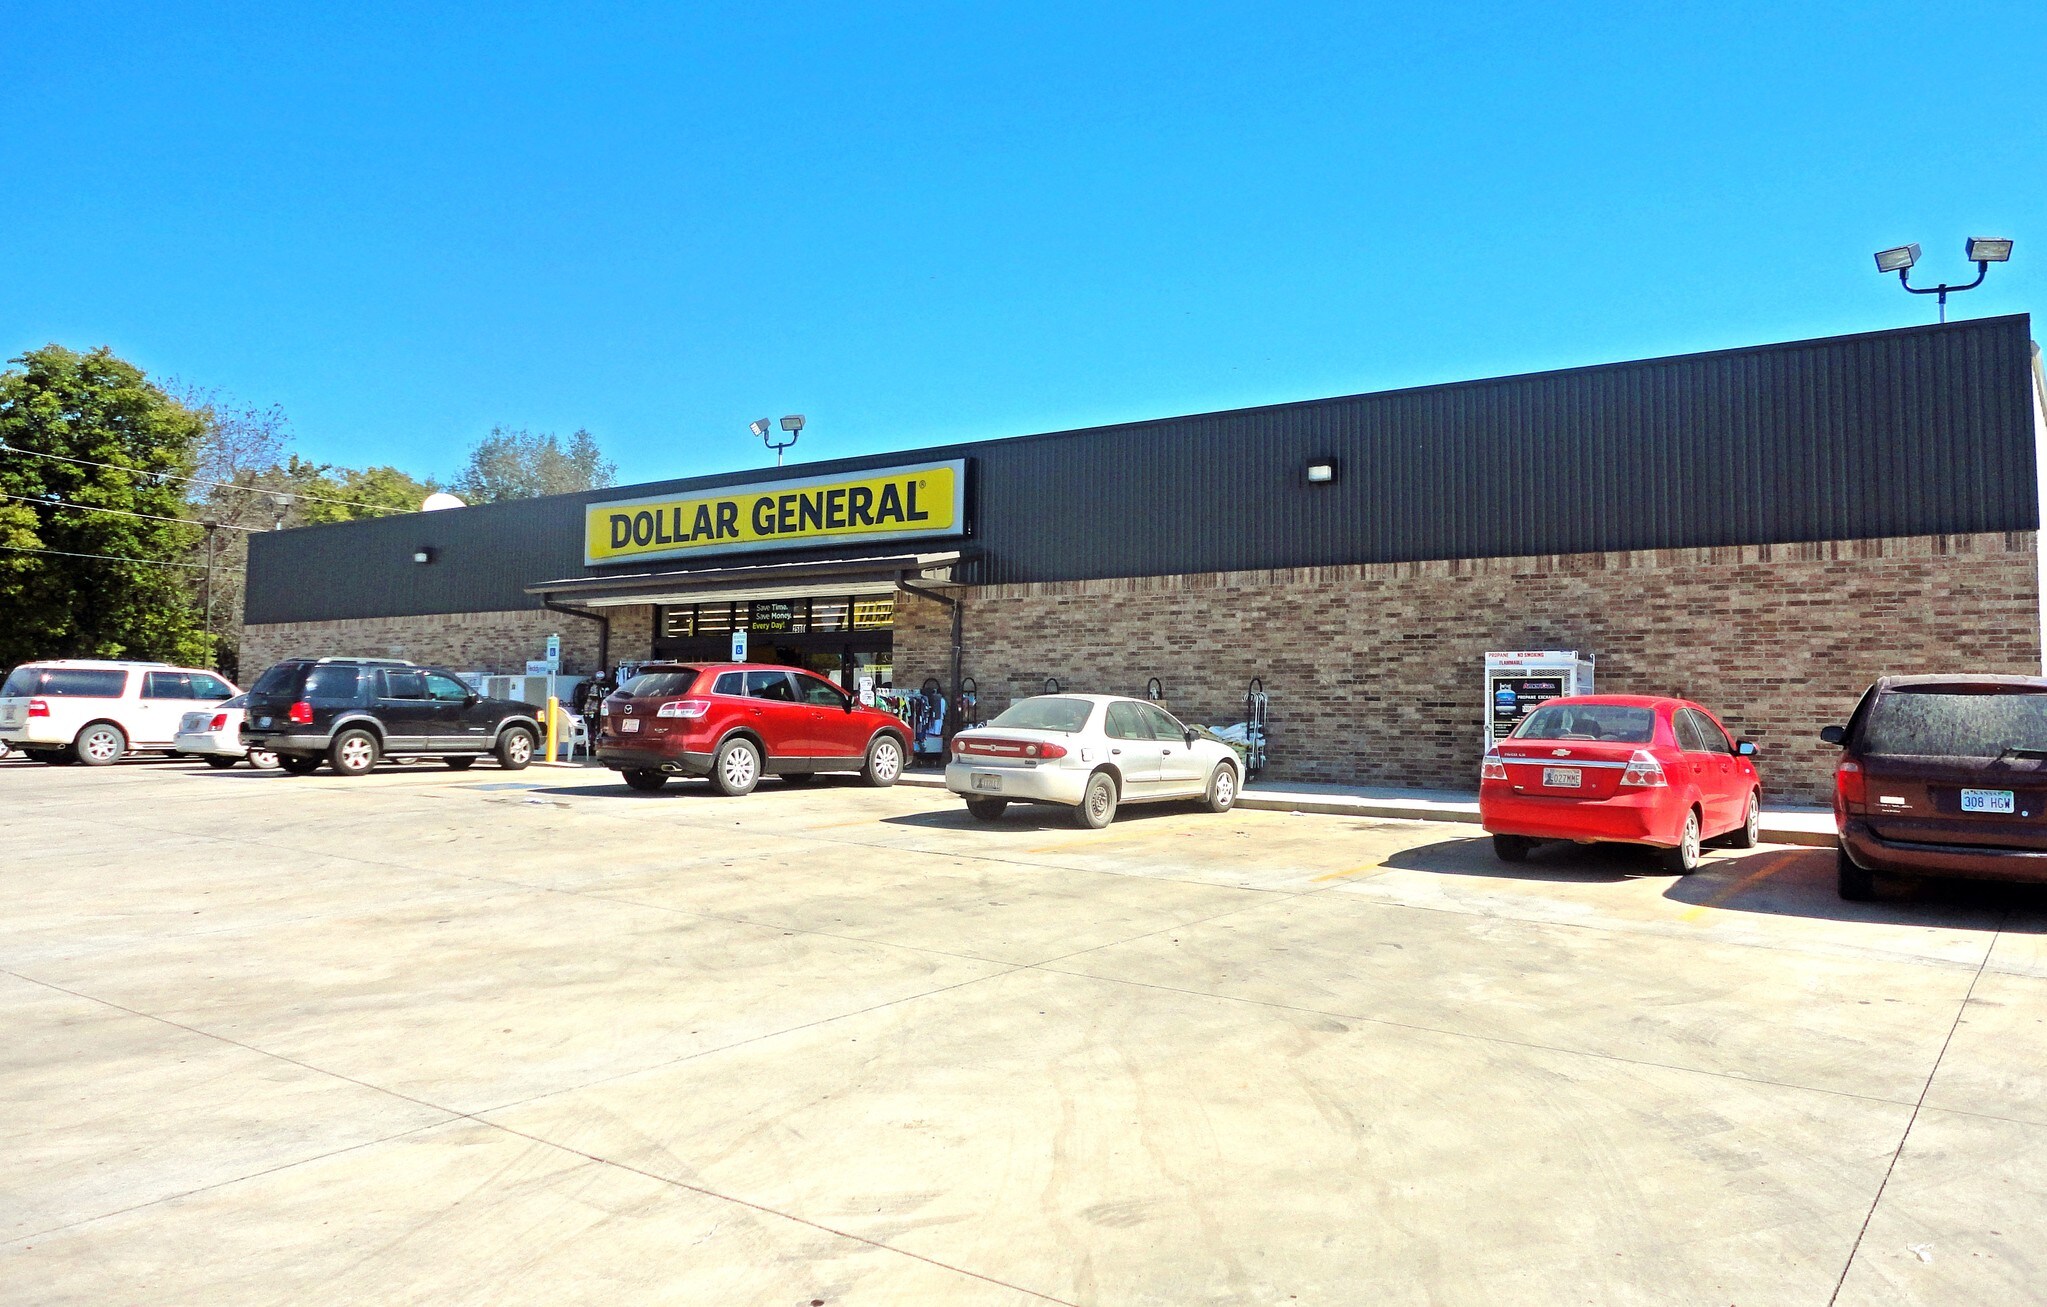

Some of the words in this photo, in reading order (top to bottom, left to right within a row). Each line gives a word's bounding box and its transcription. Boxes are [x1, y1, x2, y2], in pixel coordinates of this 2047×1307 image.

[610, 501, 739, 549] DOLLAR
[771, 603, 788, 611] Time.
[756, 612, 771, 620] Save
[771, 612, 792, 620] Money.
[752, 622, 770, 630] Every
[1964, 796, 1984, 808] 308
[1990, 797, 2011, 809] HGW
